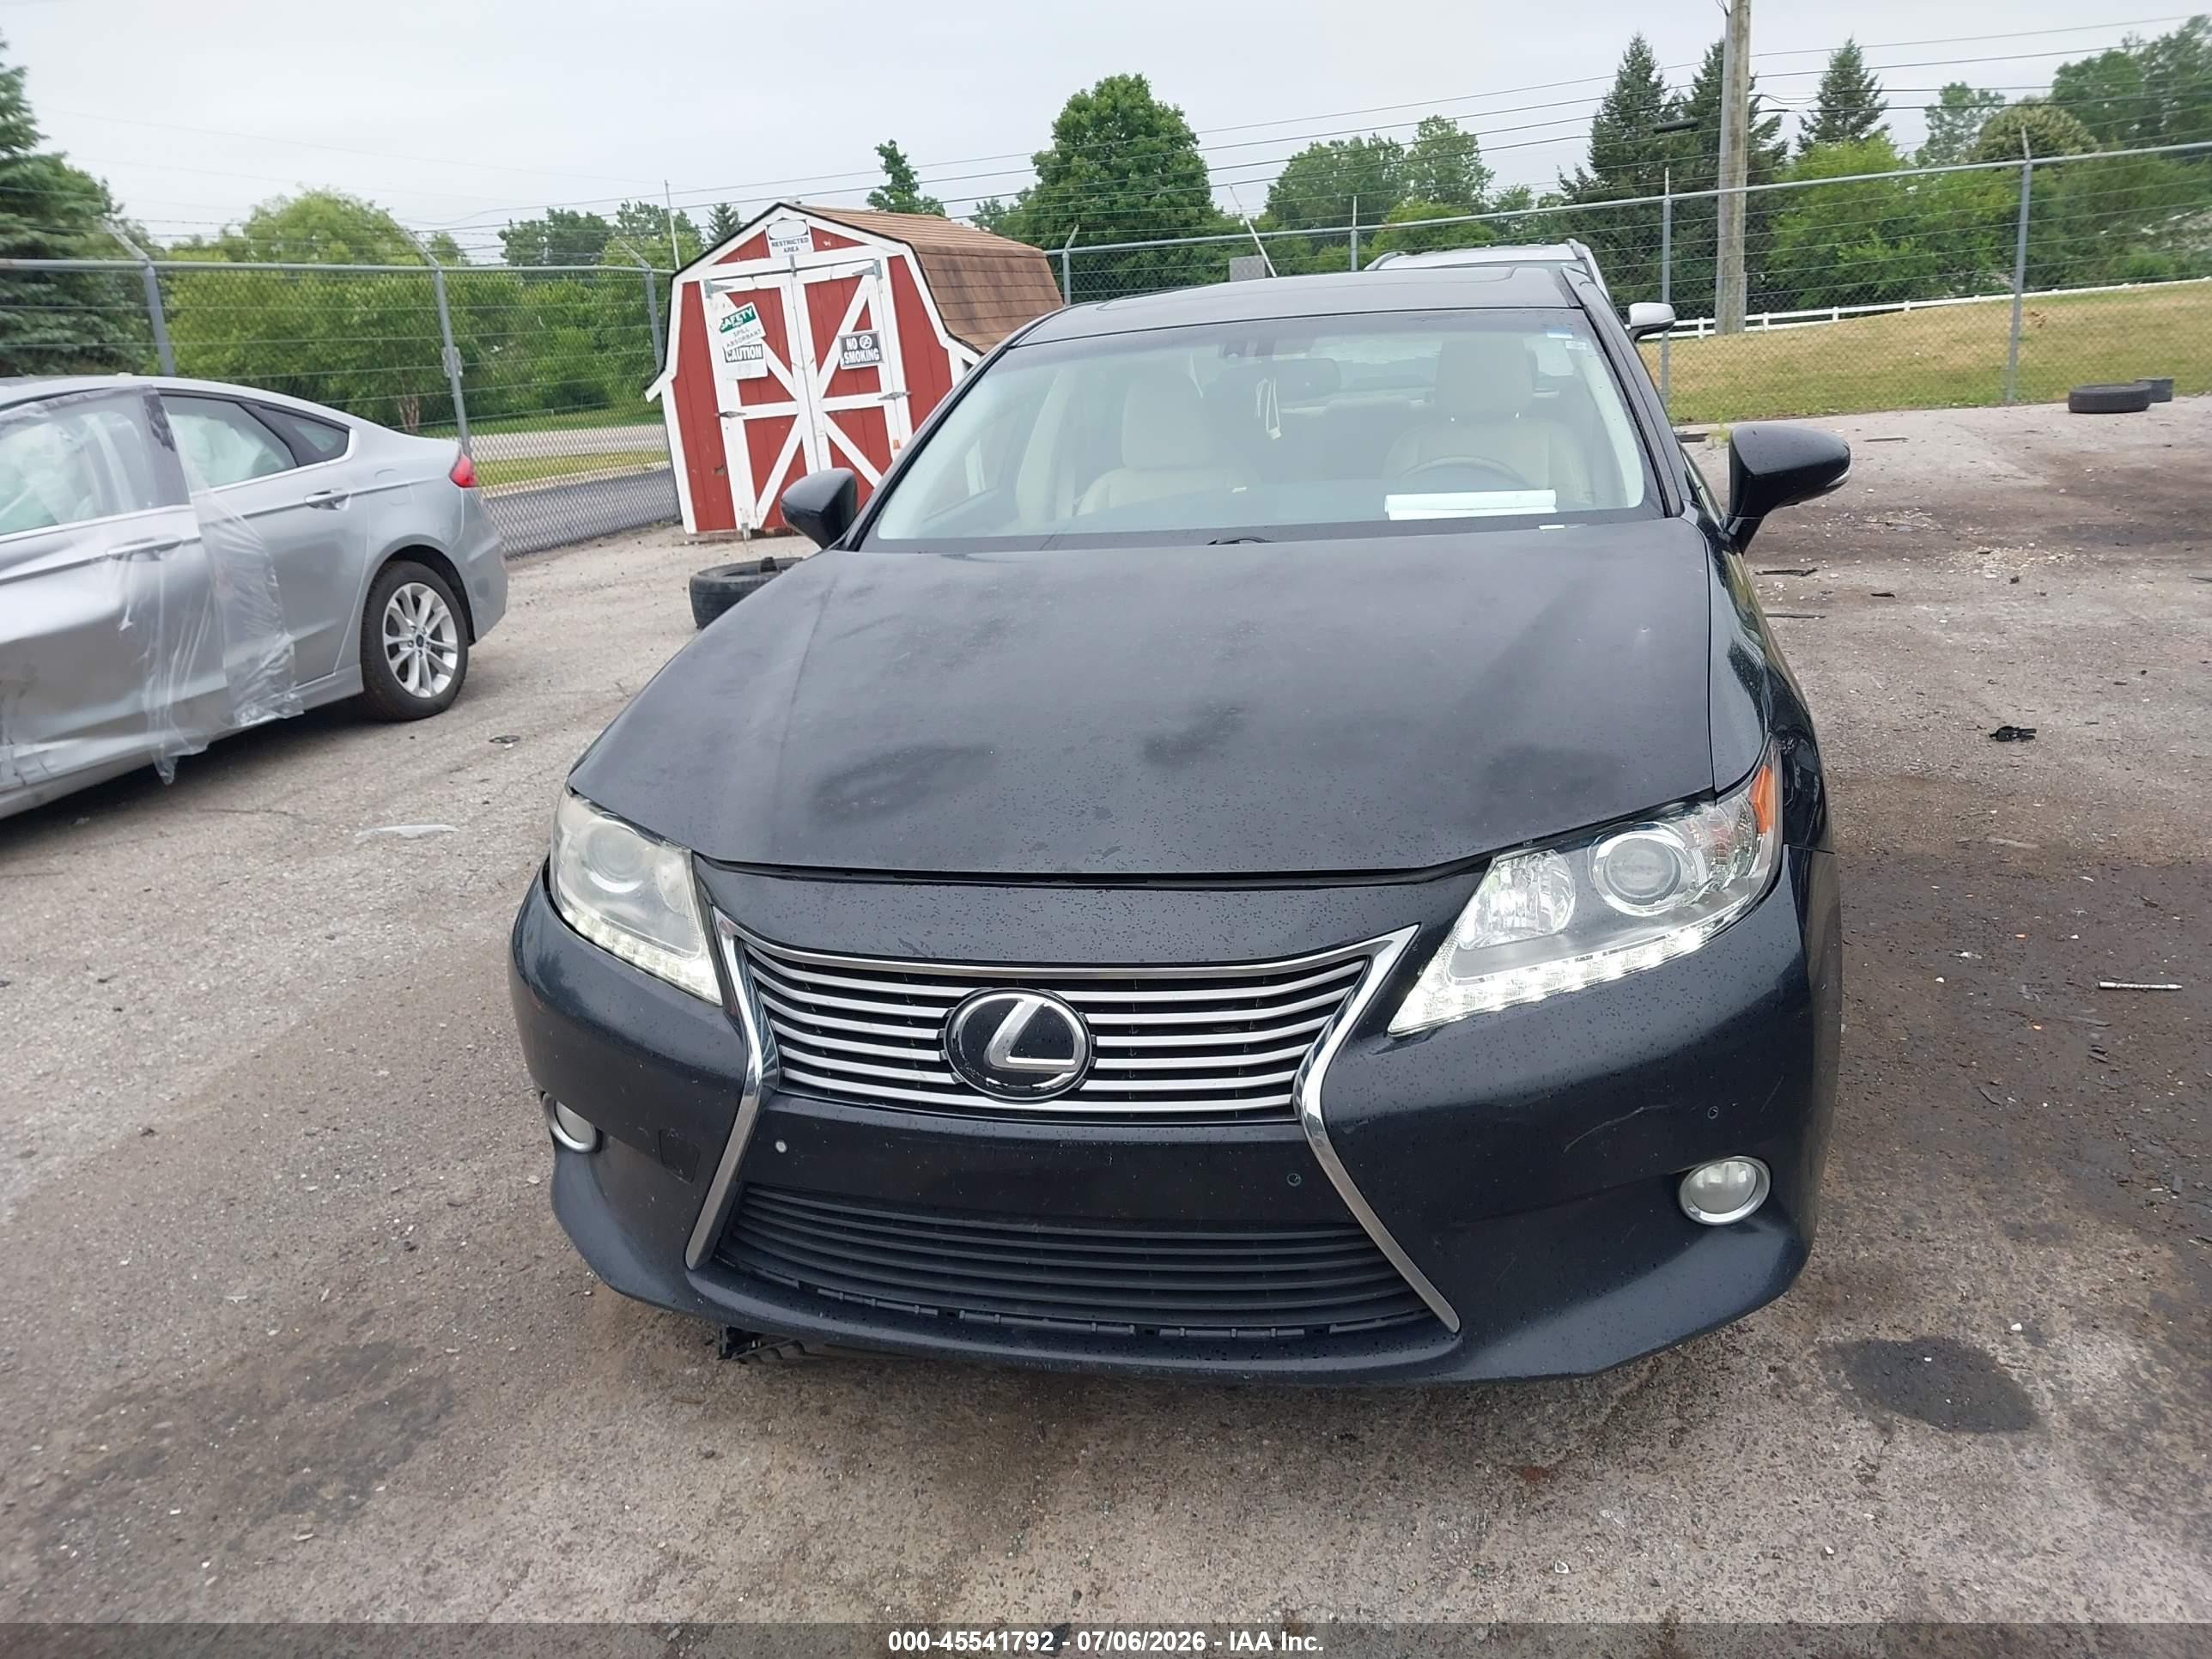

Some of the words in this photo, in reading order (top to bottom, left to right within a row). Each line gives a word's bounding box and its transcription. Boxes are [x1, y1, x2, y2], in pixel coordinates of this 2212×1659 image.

[771, 237, 809, 247] RESTRICTED
[720, 307, 753, 331] SAFETY
[846, 337, 858, 351] NO
[726, 345, 762, 362] CAUTION
[844, 347, 880, 365] SMOKING
